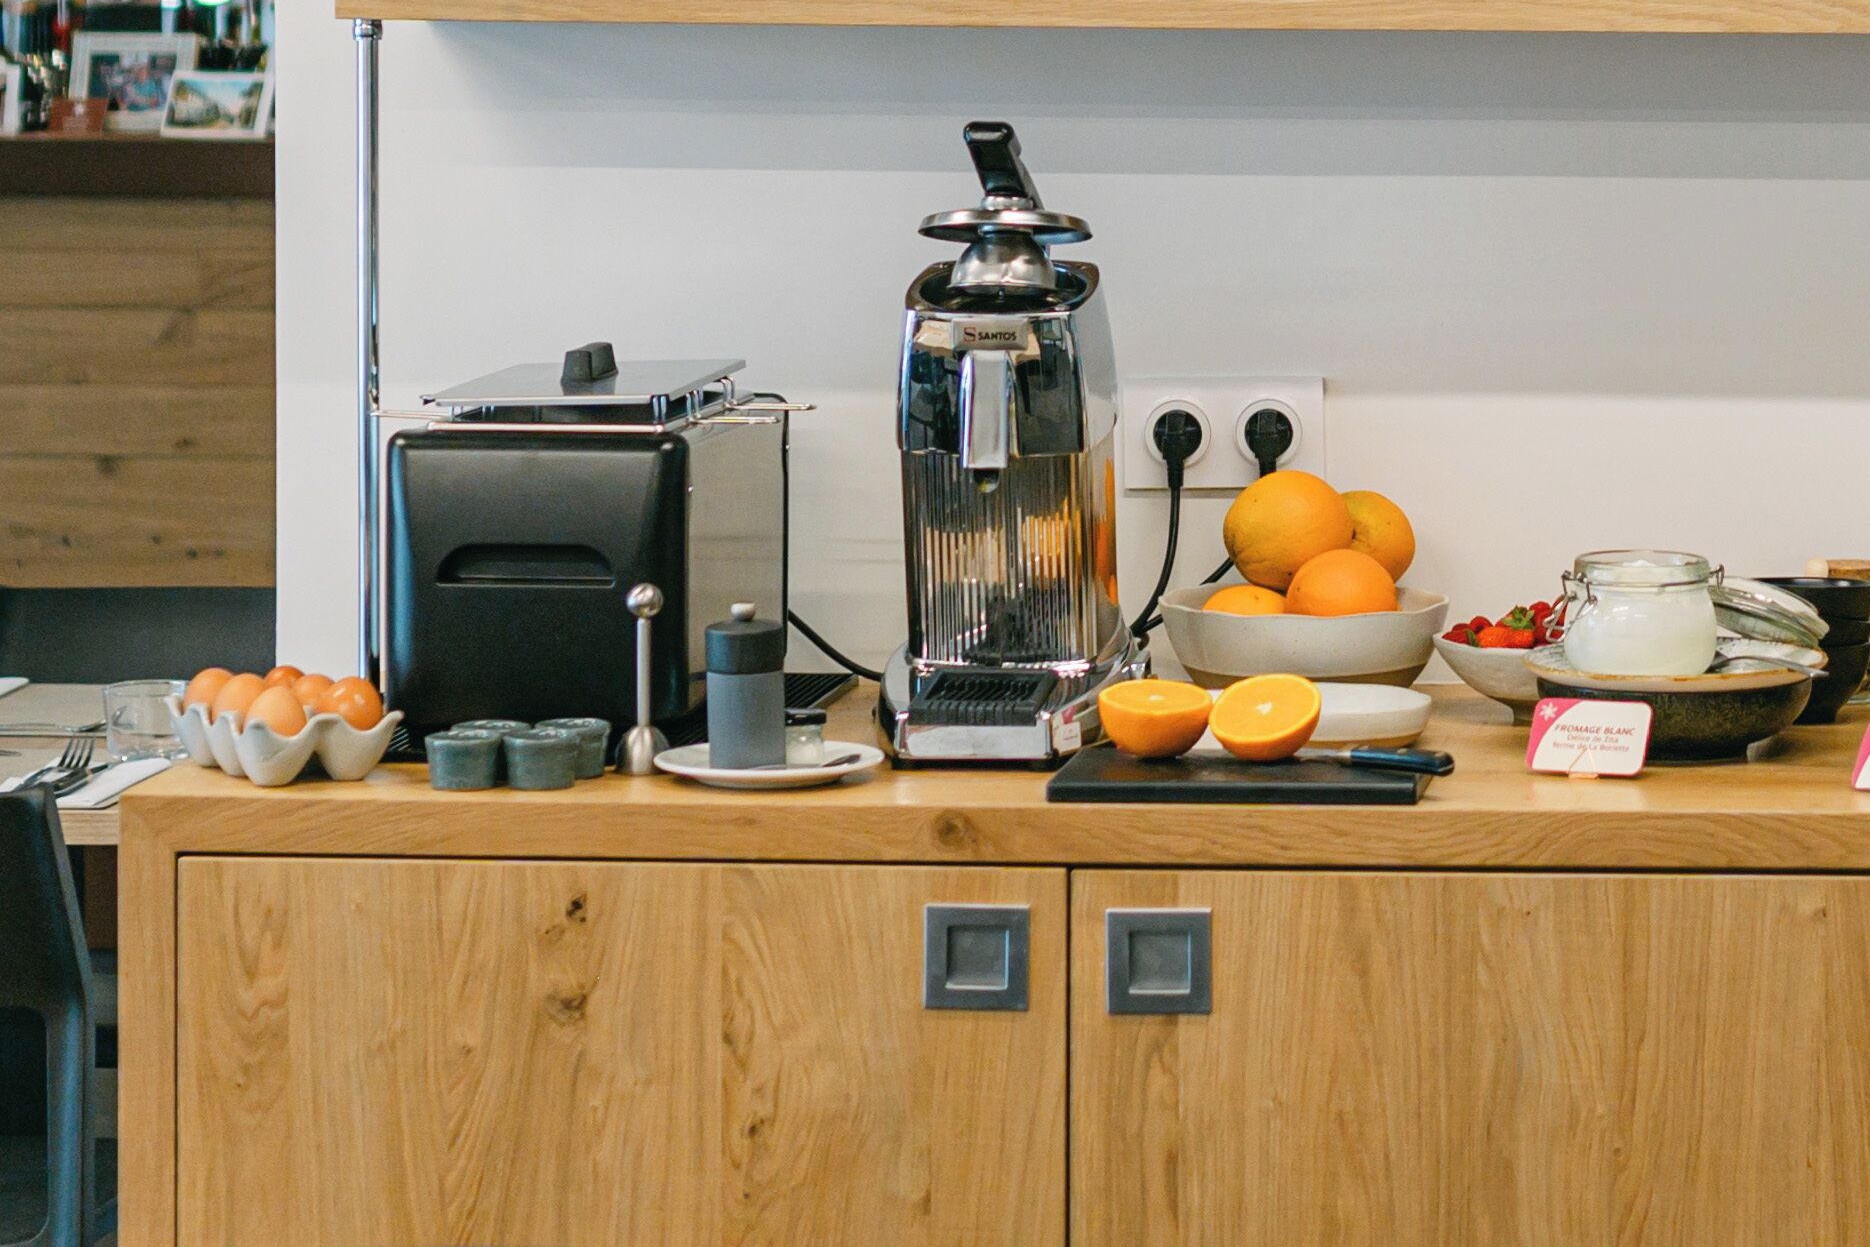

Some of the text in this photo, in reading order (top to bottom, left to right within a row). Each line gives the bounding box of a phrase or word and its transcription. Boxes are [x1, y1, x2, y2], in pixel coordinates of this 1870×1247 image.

[978, 331, 1017, 341] SANTOS
[1554, 724, 1635, 736] FROMAGE BLANC
